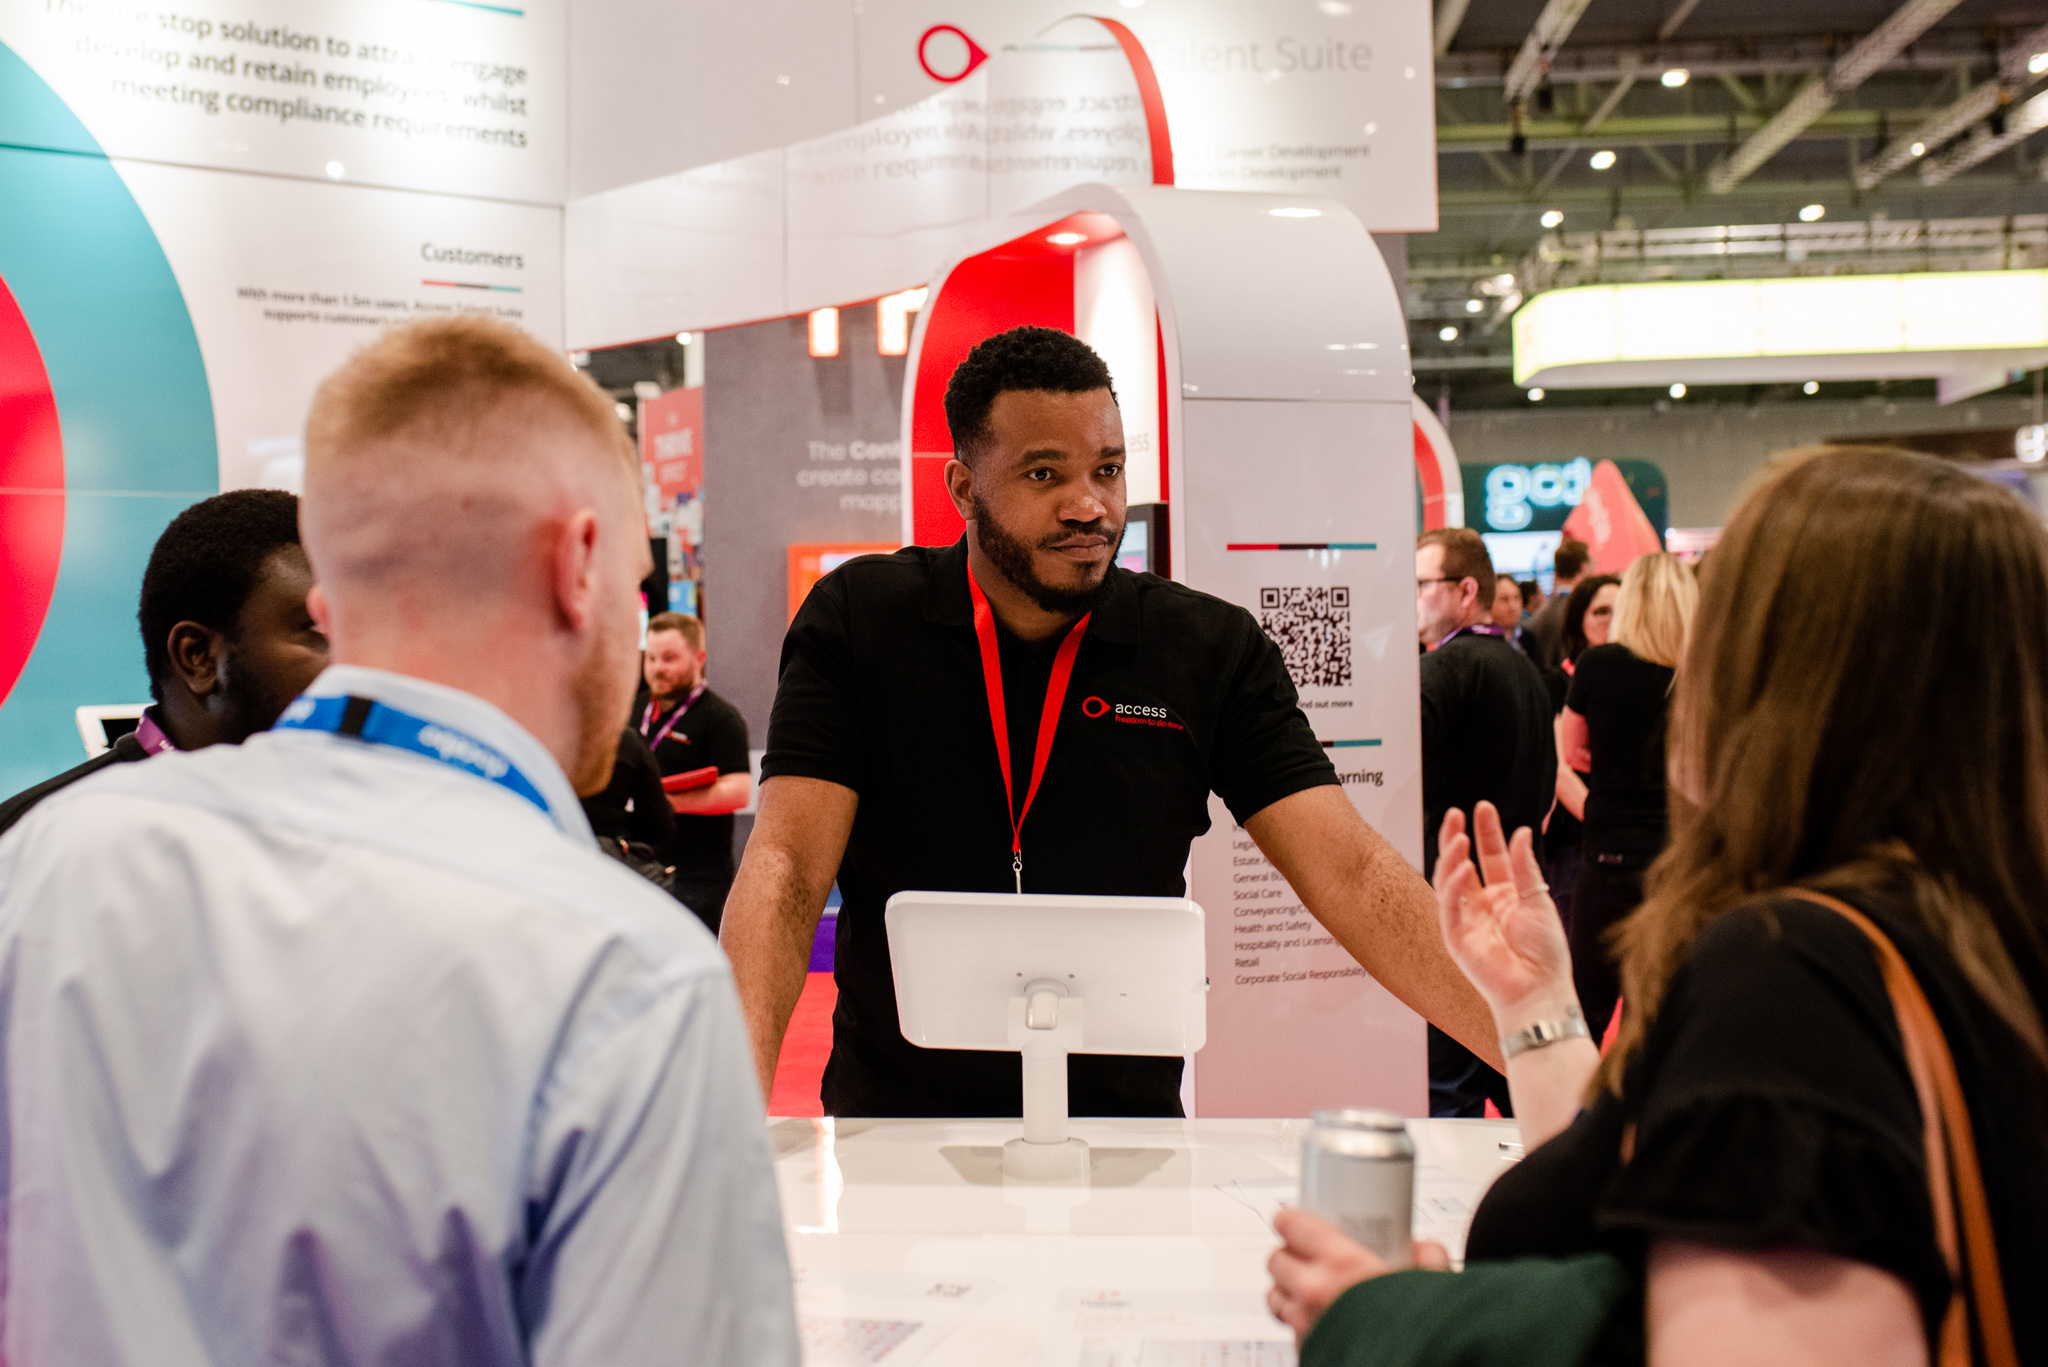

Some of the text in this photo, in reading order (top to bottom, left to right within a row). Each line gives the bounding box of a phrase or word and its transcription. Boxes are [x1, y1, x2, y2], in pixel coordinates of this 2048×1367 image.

[159, 13, 213, 41] stop
[219, 20, 319, 52] solution
[326, 35, 351, 57] to
[450, 59, 528, 87] engage
[1275, 36, 1374, 73] Suite
[188, 51, 237, 76] and
[242, 57, 318, 85] retain
[463, 92, 528, 117] whilst
[111, 79, 529, 149] meeting compliance requirements
[421, 242, 525, 270] Customers
[235, 286, 267, 301] With
[271, 290, 305, 303] more
[308, 291, 338, 306] than
[263, 308, 321, 324] supports
[807, 440, 847, 460] The
[796, 467, 868, 487] create
[1115, 703, 1167, 719] access
[1314, 700, 1329, 709] out
[1330, 700, 1353, 709] more
[1115, 714, 1184, 731] freedom to do more
[1338, 768, 1384, 787] arning
[1232, 839, 1257, 852] Lega
[1233, 856, 1260, 867] Estate
[1233, 872, 1269, 884] General
[1233, 888, 1282, 901] Social Care
[1234, 920, 1312, 934] Health and Safety
[1234, 939, 1281, 952] Hospitality
[1282, 938, 1301, 948] and
[1234, 957, 1260, 968] Retail
[1234, 966, 1367, 986] Corporate Social Responsibility
